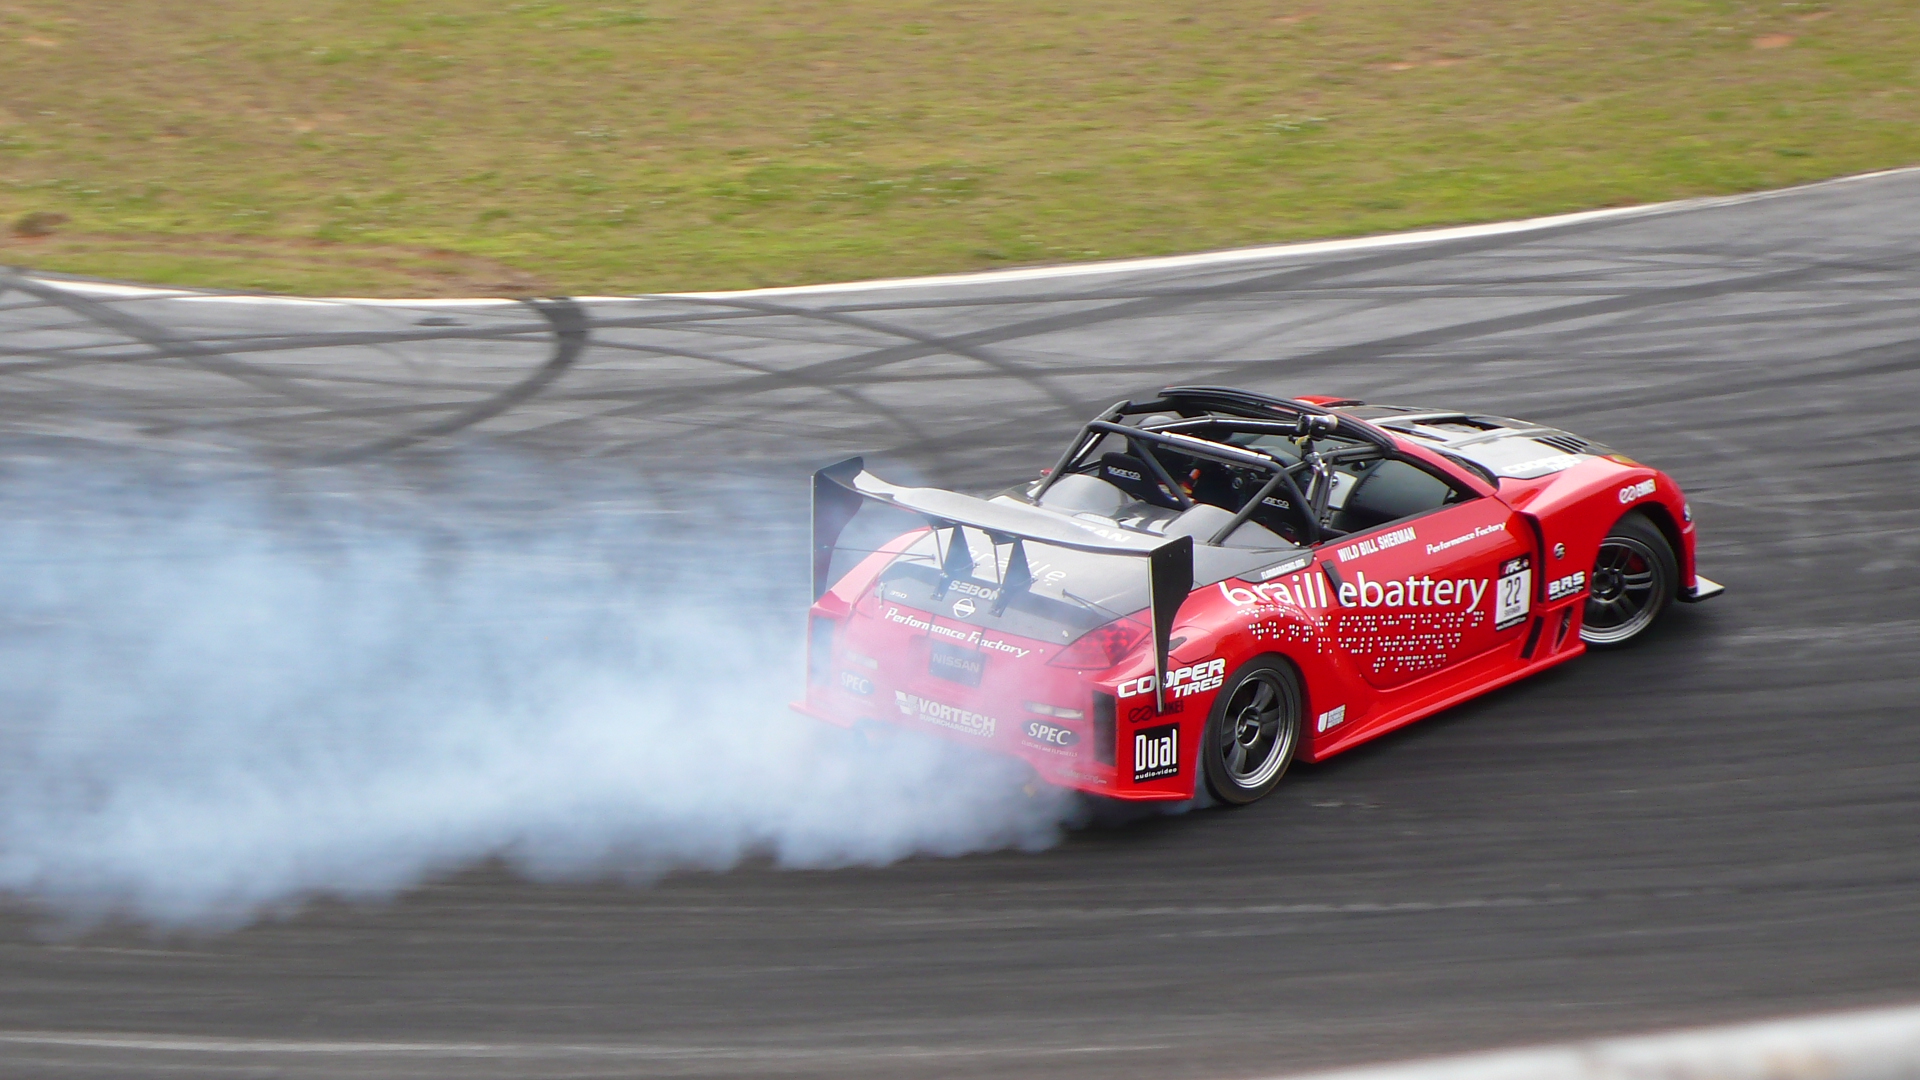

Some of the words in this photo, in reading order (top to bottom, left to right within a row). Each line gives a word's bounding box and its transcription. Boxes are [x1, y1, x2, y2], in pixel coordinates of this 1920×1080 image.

[1337, 544, 1360, 563] WILD
[1358, 535, 1379, 556] BILL
[1377, 526, 1417, 551] SHERMAN
[1426, 532, 1476, 555] Performance
[1474, 521, 1507, 538] Factory
[1505, 576, 1521, 607] 22
[1548, 571, 1585, 596] BRS
[885, 607, 967, 641] Performance
[967, 630, 1030, 658] Factory
[932, 653, 981, 673] NISSAN
[841, 671, 870, 694] SPEC
[1173, 674, 1224, 698] TIRES
[918, 697, 997, 732] VORTECH
[1027, 722, 1072, 745] SPEC
[1135, 728, 1178, 772] Dual
